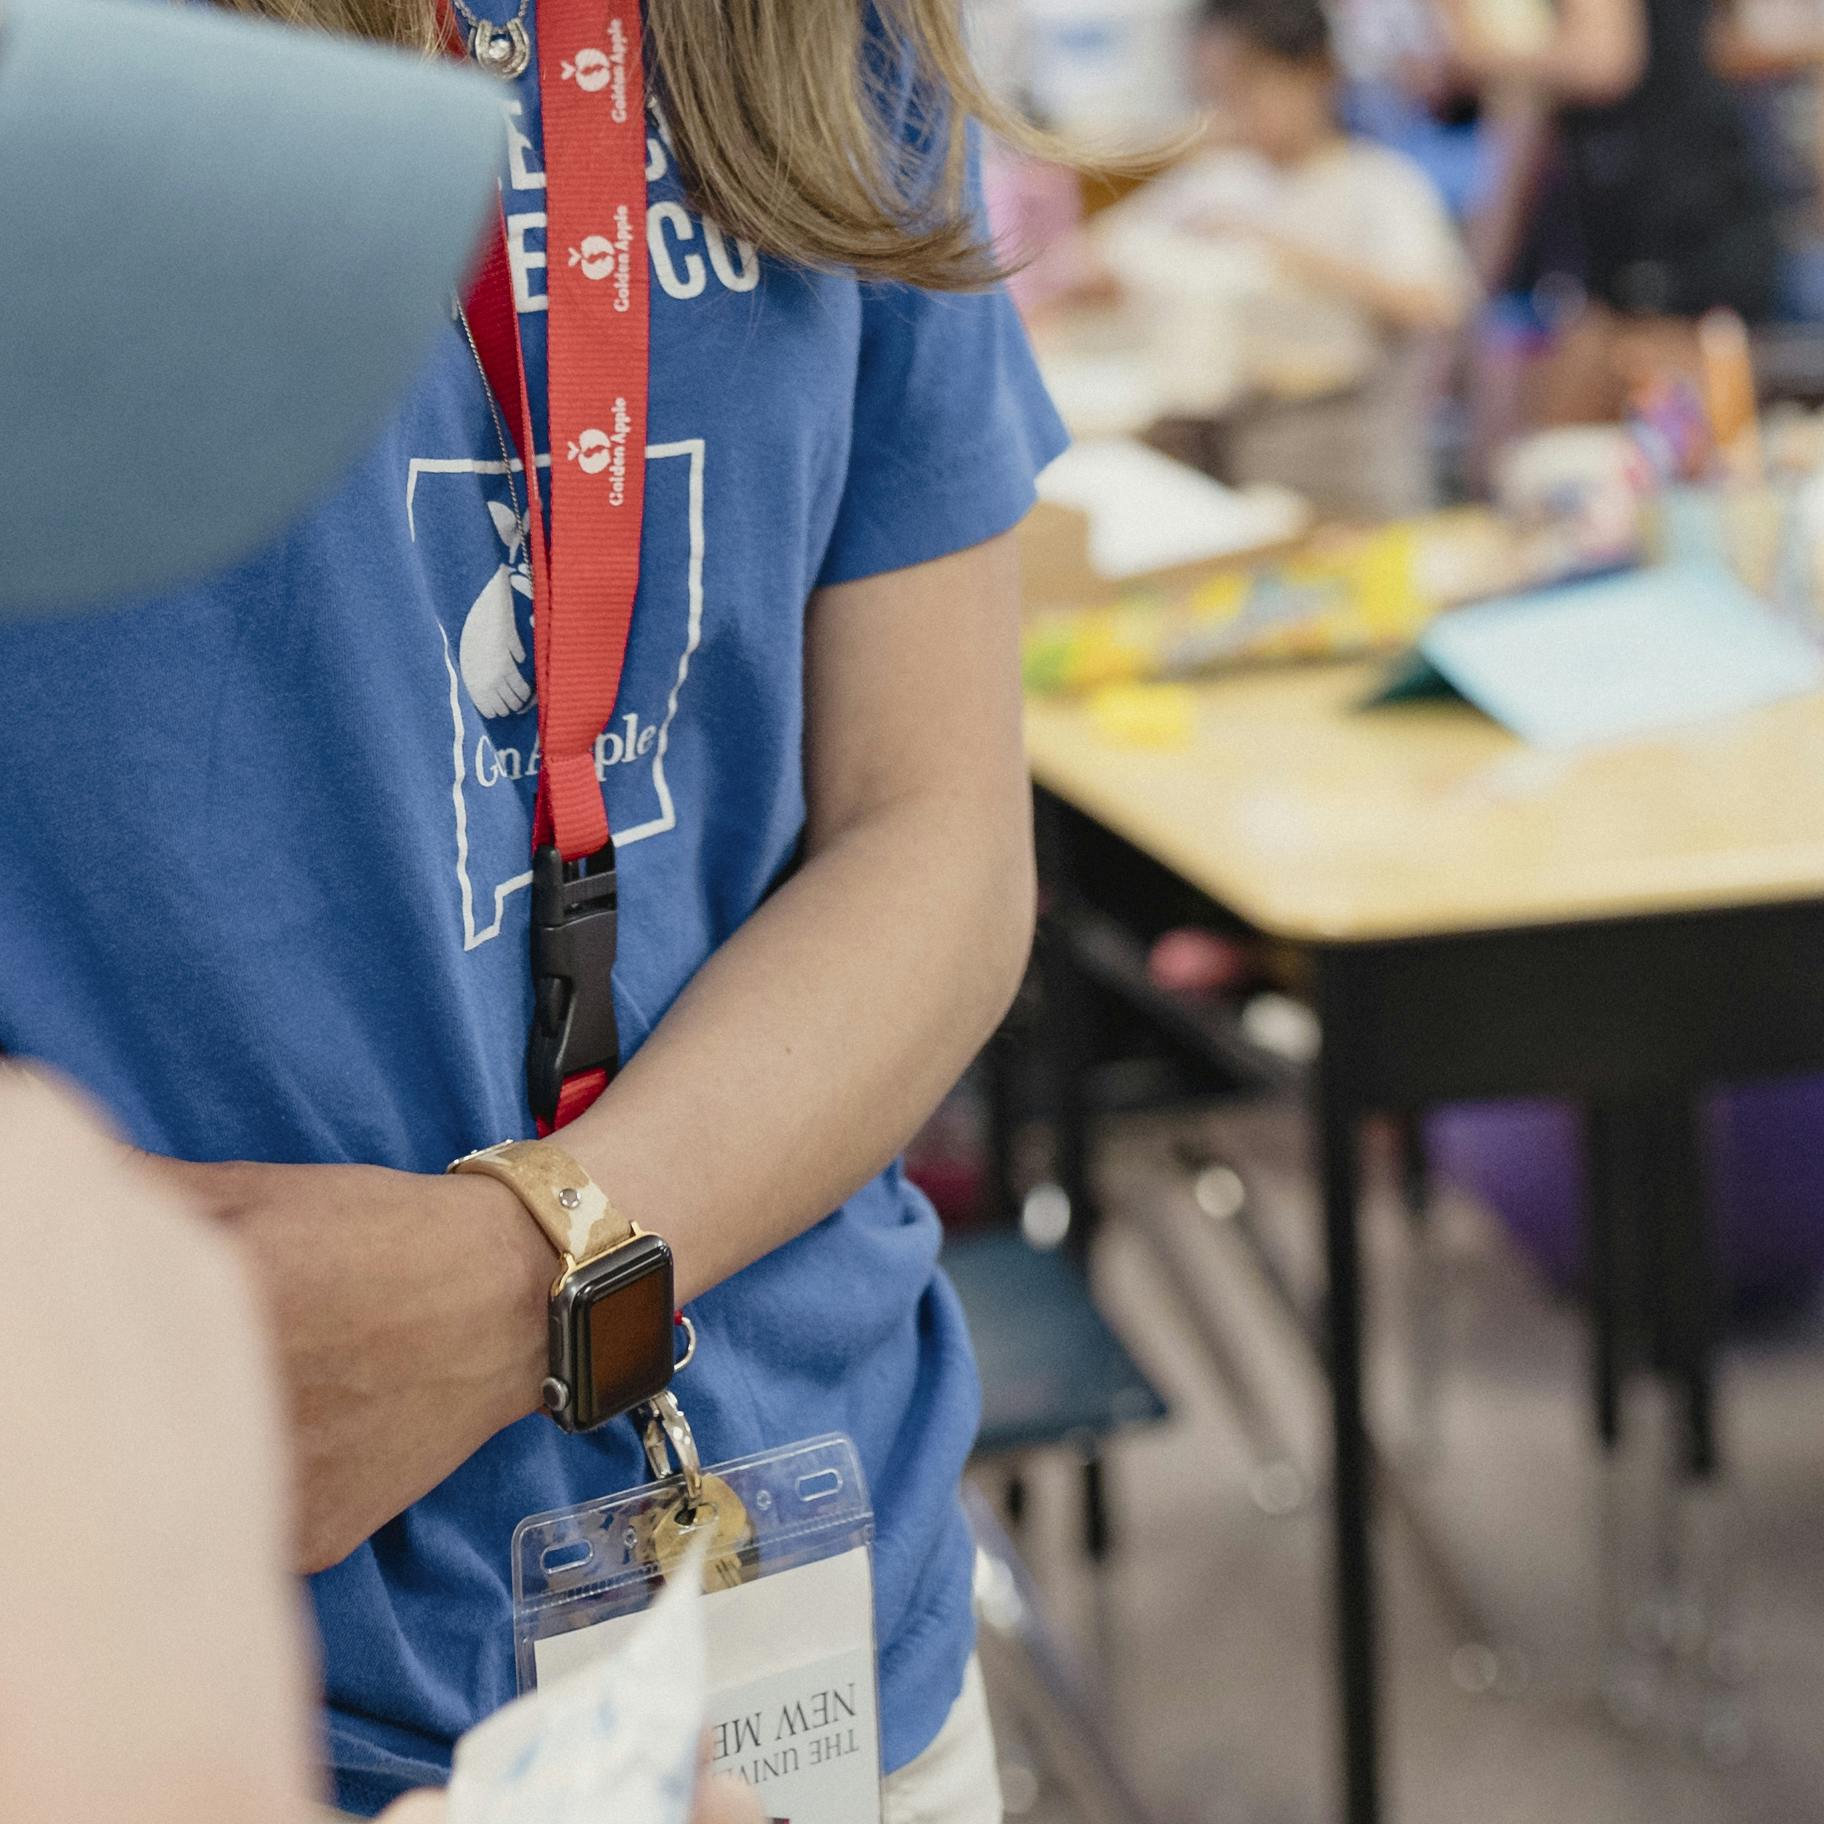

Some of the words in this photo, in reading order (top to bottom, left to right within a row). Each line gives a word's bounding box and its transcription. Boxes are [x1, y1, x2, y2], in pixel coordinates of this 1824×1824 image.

[613, 204, 633, 253] Apple
[613, 253, 630, 313] Golden
[609, 397, 631, 445] Apple
[608, 446, 625, 507] Golden
[711, 1711, 763, 1762] ME
[774, 1682, 857, 1742] NEW
[808, 1728, 860, 1766] THE
